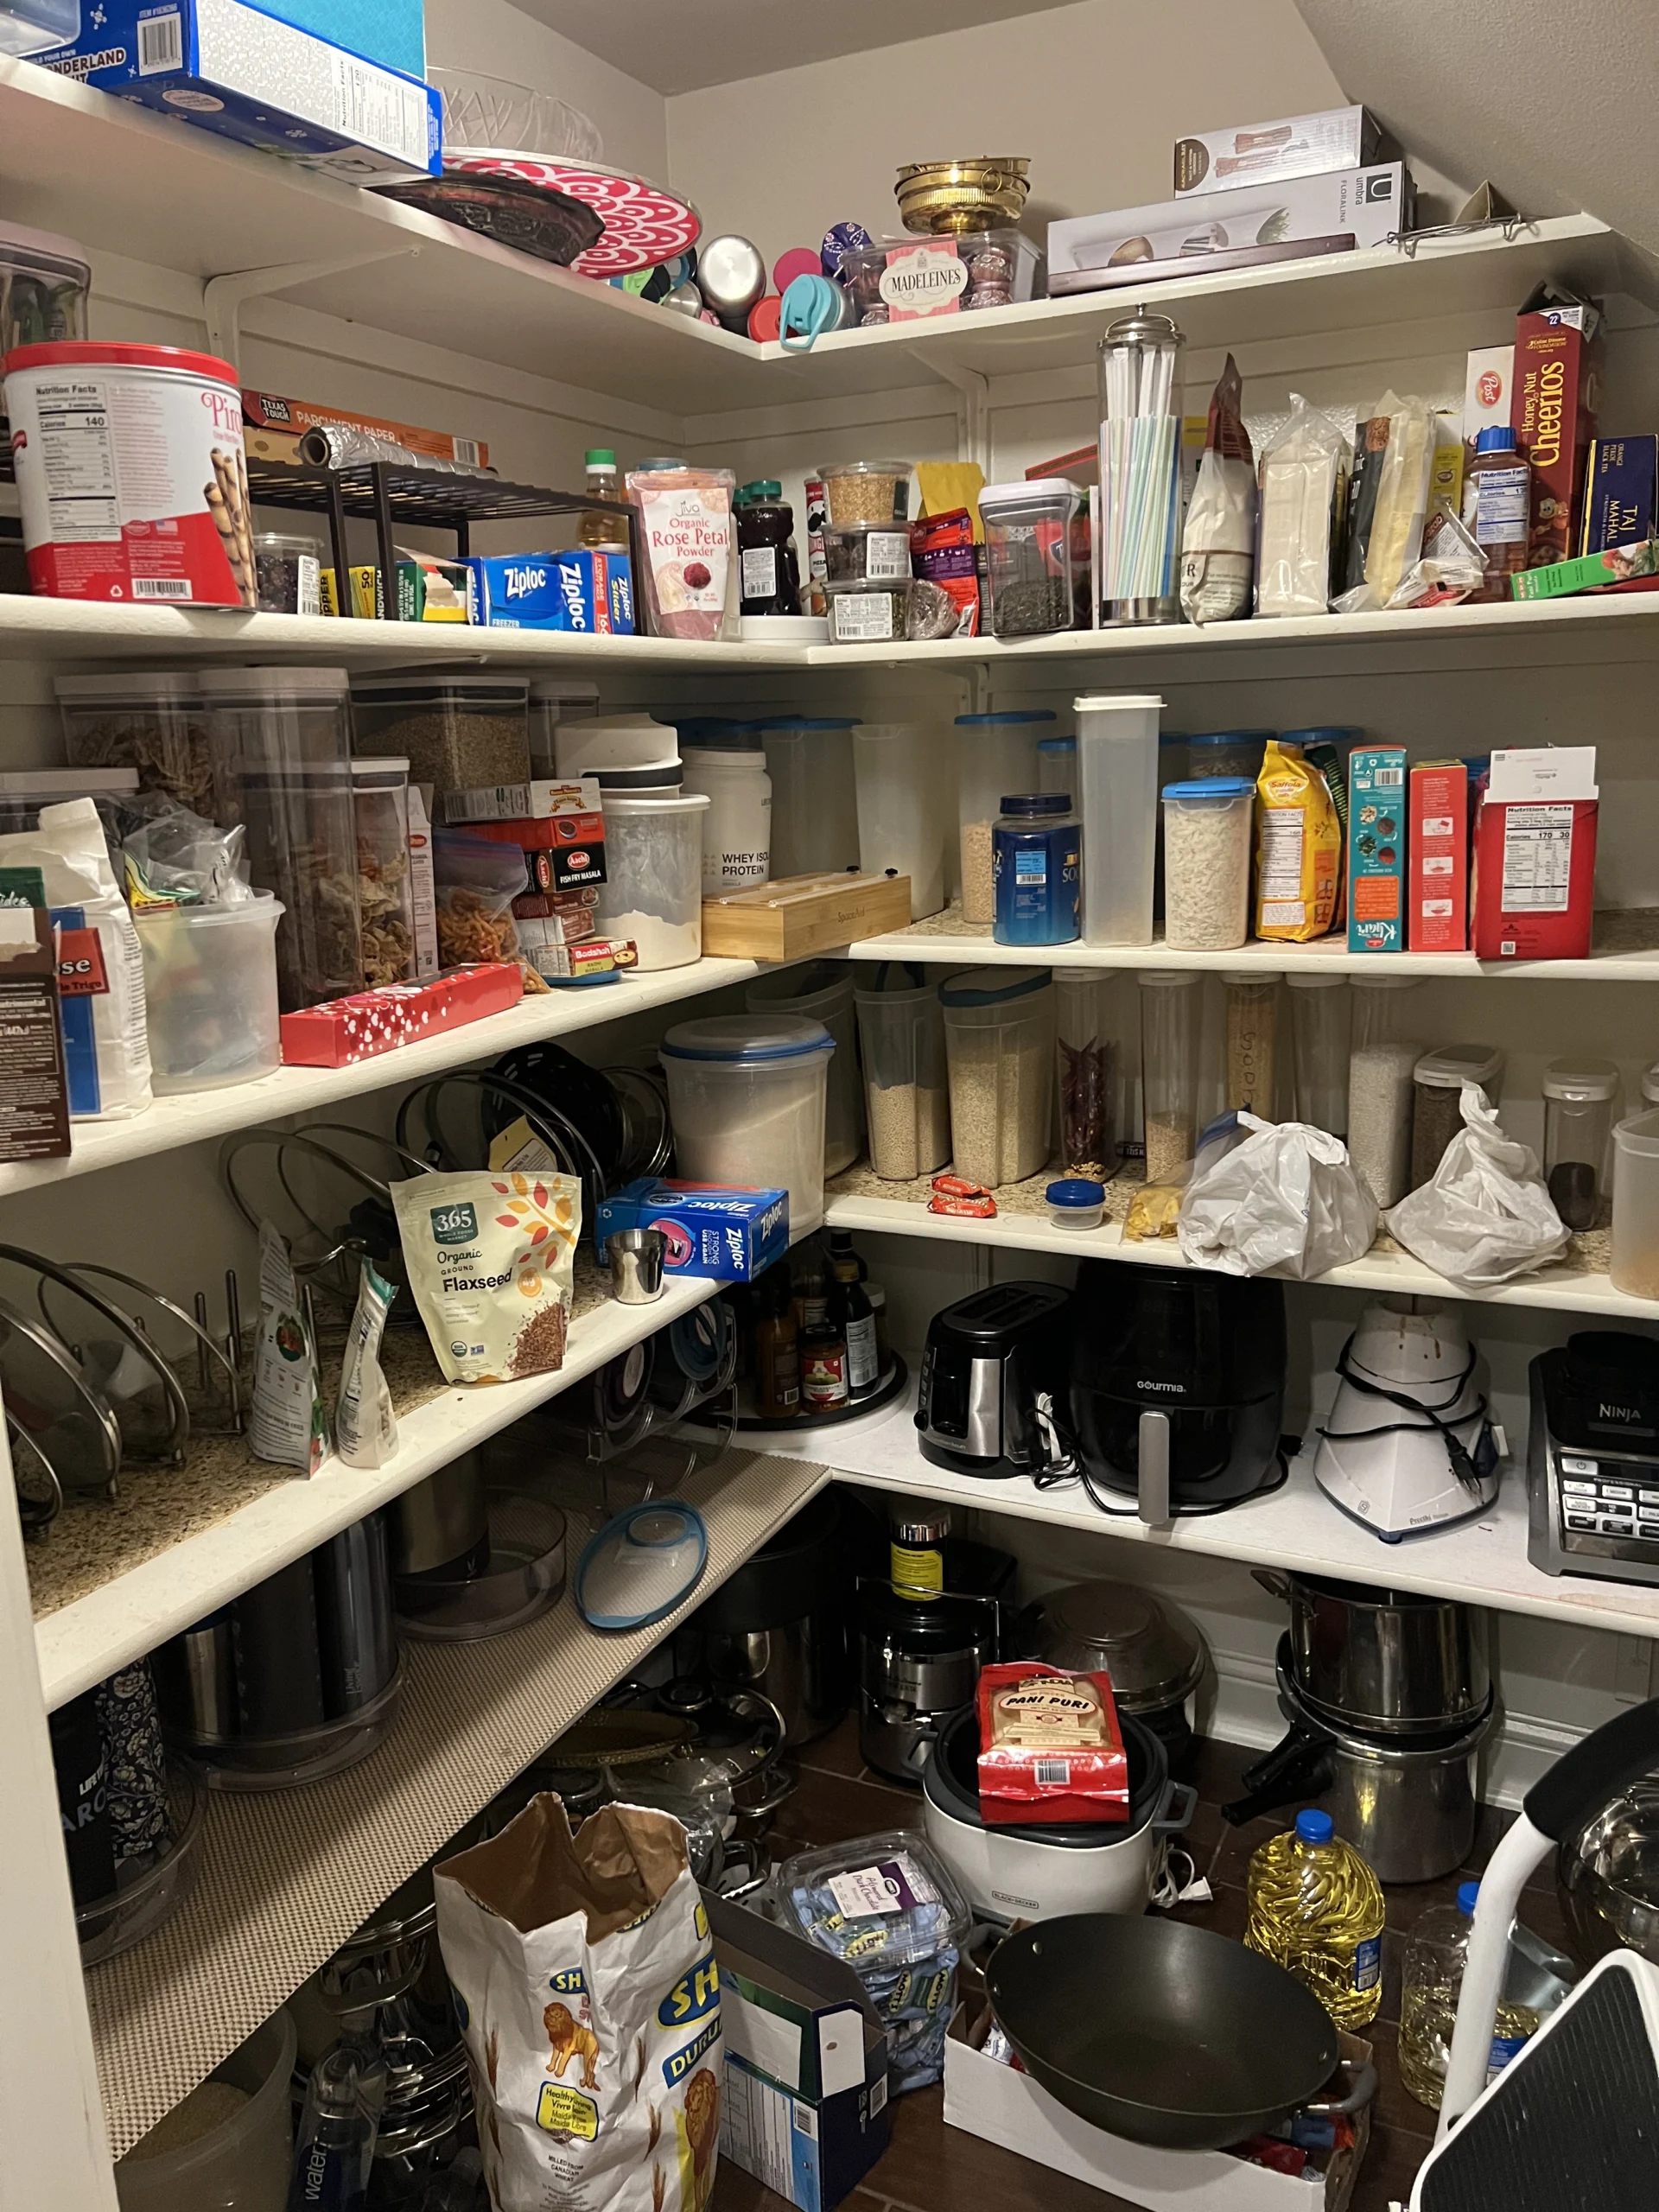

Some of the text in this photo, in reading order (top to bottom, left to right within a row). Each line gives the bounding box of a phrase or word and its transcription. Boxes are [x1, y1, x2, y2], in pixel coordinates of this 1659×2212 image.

[48, 48, 126, 75] ONDERLAND
[1355, 177, 1363, 207] umbra
[892, 268, 961, 293] MADELEINES
[1549, 315, 1558, 325] 22
[1483, 375, 1497, 406] Post
[261, 398, 286, 412] TEXAS
[1522, 372, 1538, 432] Honey Nut
[86, 416, 105, 426] 140
[264, 407, 289, 422] TOUGH
[1529, 361, 1564, 467] Cheerios
[364, 424, 396, 444] PAPER
[670, 518, 710, 529] Organic
[1606, 500, 1621, 543] MAHAL
[1622, 505, 1638, 531] TAJ
[652, 528, 728, 548] Rose Petal
[677, 546, 715, 557] Powder
[362, 571, 370, 589] 50
[504, 566, 546, 599] Ziploc
[560, 563, 587, 630] Ziploc
[611, 580, 620, 625] Slider
[618, 576, 632, 620] Ziploc
[492, 618, 520, 628] FREEZER
[1270, 780, 1302, 789] Saffola
[568, 852, 589, 866] Aachi
[722, 853, 754, 864] WHEY
[539, 856, 550, 888] Aachi
[560, 869, 601, 885] FISH FRY MASALA
[722, 865, 764, 876] PROTEIN
[575, 946, 610, 959] Badshah
[59, 957, 91, 976] se
[73, 978, 102, 991] Trigo
[688, 1200, 757, 1213] Ziploc
[436, 1209, 473, 1232] 365
[760, 1200, 783, 1243] Ziploc
[436, 1249, 483, 1265] Organic
[726, 1227, 745, 1270] Ziploc
[441, 1265, 474, 1276] GROUND
[442, 1267, 513, 1293] Flaxseed
[1599, 1403, 1642, 1422] NINJA
[1006, 1695, 1046, 1707] PANI
[1048, 1697, 1090, 1710] PURI
[546, 2088, 574, 2103] Healthy
[552, 2099, 572, 2110] Vivre
[549, 2155, 568, 2166] MILLED
[305, 2146, 327, 2201] water
[550, 2164, 580, 2176] CANADIAN
